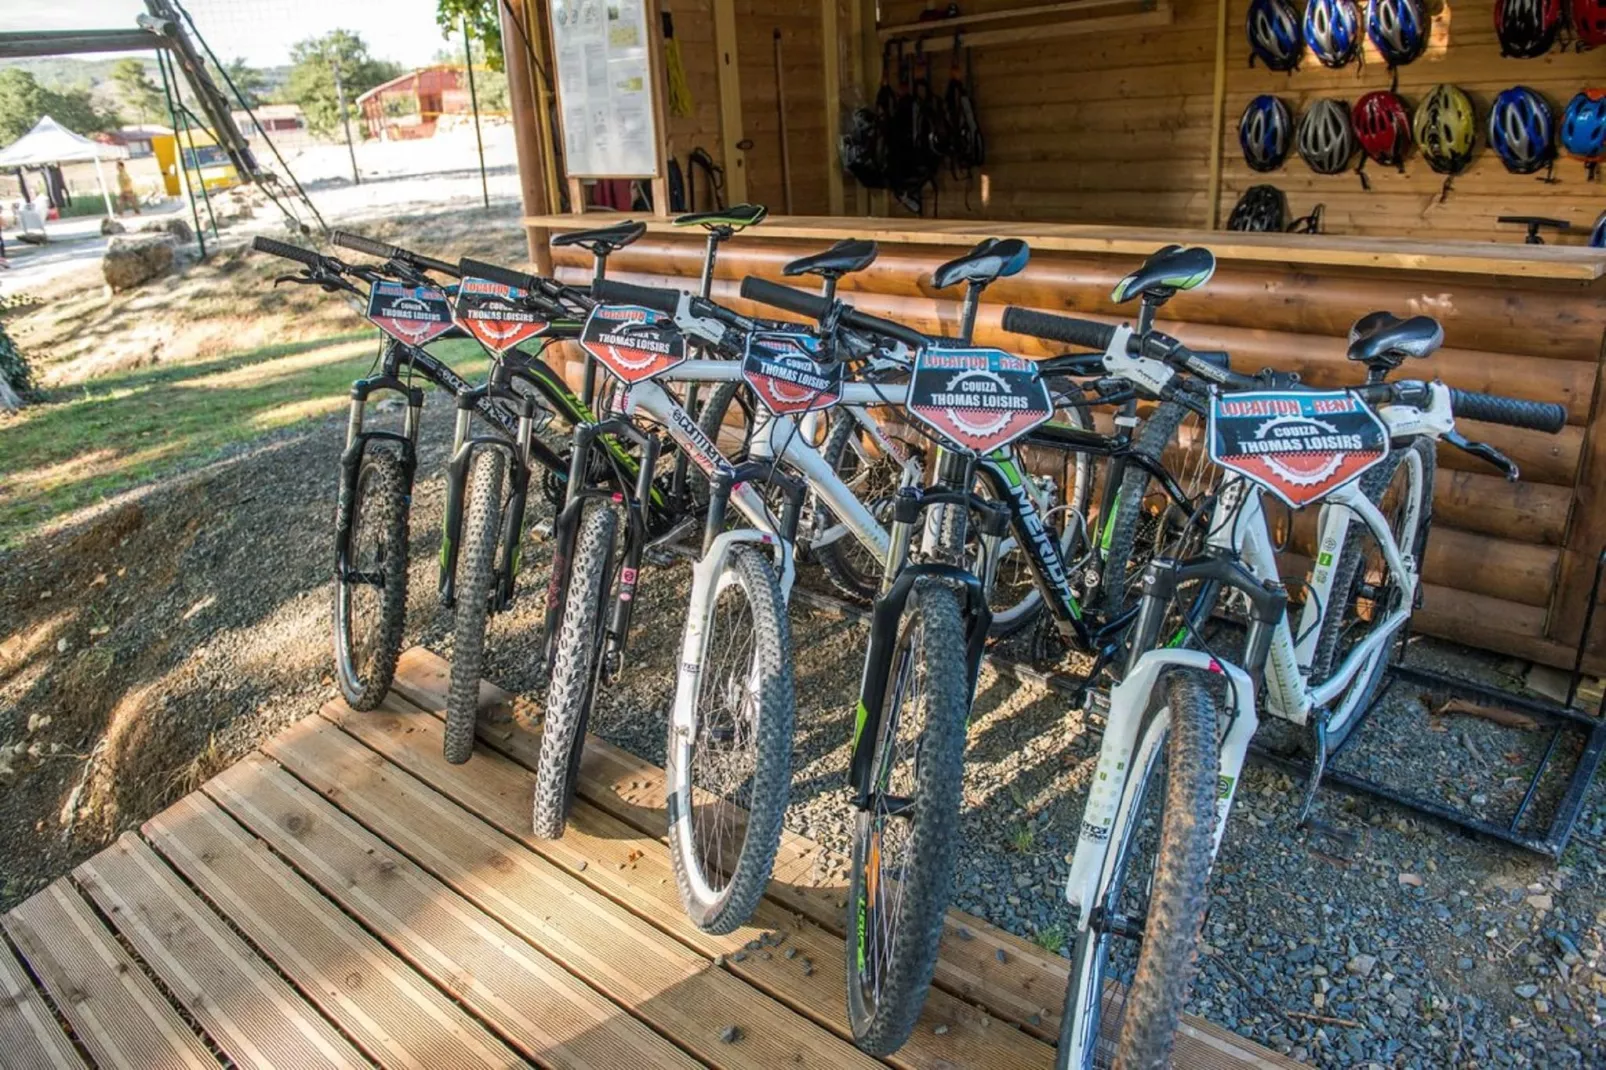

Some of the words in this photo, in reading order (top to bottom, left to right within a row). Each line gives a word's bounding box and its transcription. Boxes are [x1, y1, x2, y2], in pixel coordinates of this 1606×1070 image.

[381, 308, 413, 319] THOMAS
[413, 311, 441, 322] LOISIRS
[467, 309, 501, 320] THOMAS
[502, 311, 534, 323] LOISIRS
[598, 333, 636, 349] THOMAS
[636, 338, 671, 354] LOISIRS
[922, 354, 990, 371] LOCATION
[759, 362, 798, 383] THOMAS
[797, 371, 831, 389] LOISIRS
[961, 380, 998, 393] COUIZA
[930, 393, 981, 407] THOMAS
[982, 394, 1029, 409] LOISIRS
[1218, 399, 1303, 417] LOCATION
[1312, 398, 1357, 414] RENT
[1273, 425, 1320, 438] COUIZA
[1238, 438, 1303, 454] THOMAS
[1303, 434, 1363, 451] LOISIRS
[1009, 484, 1073, 601] MERIDA
